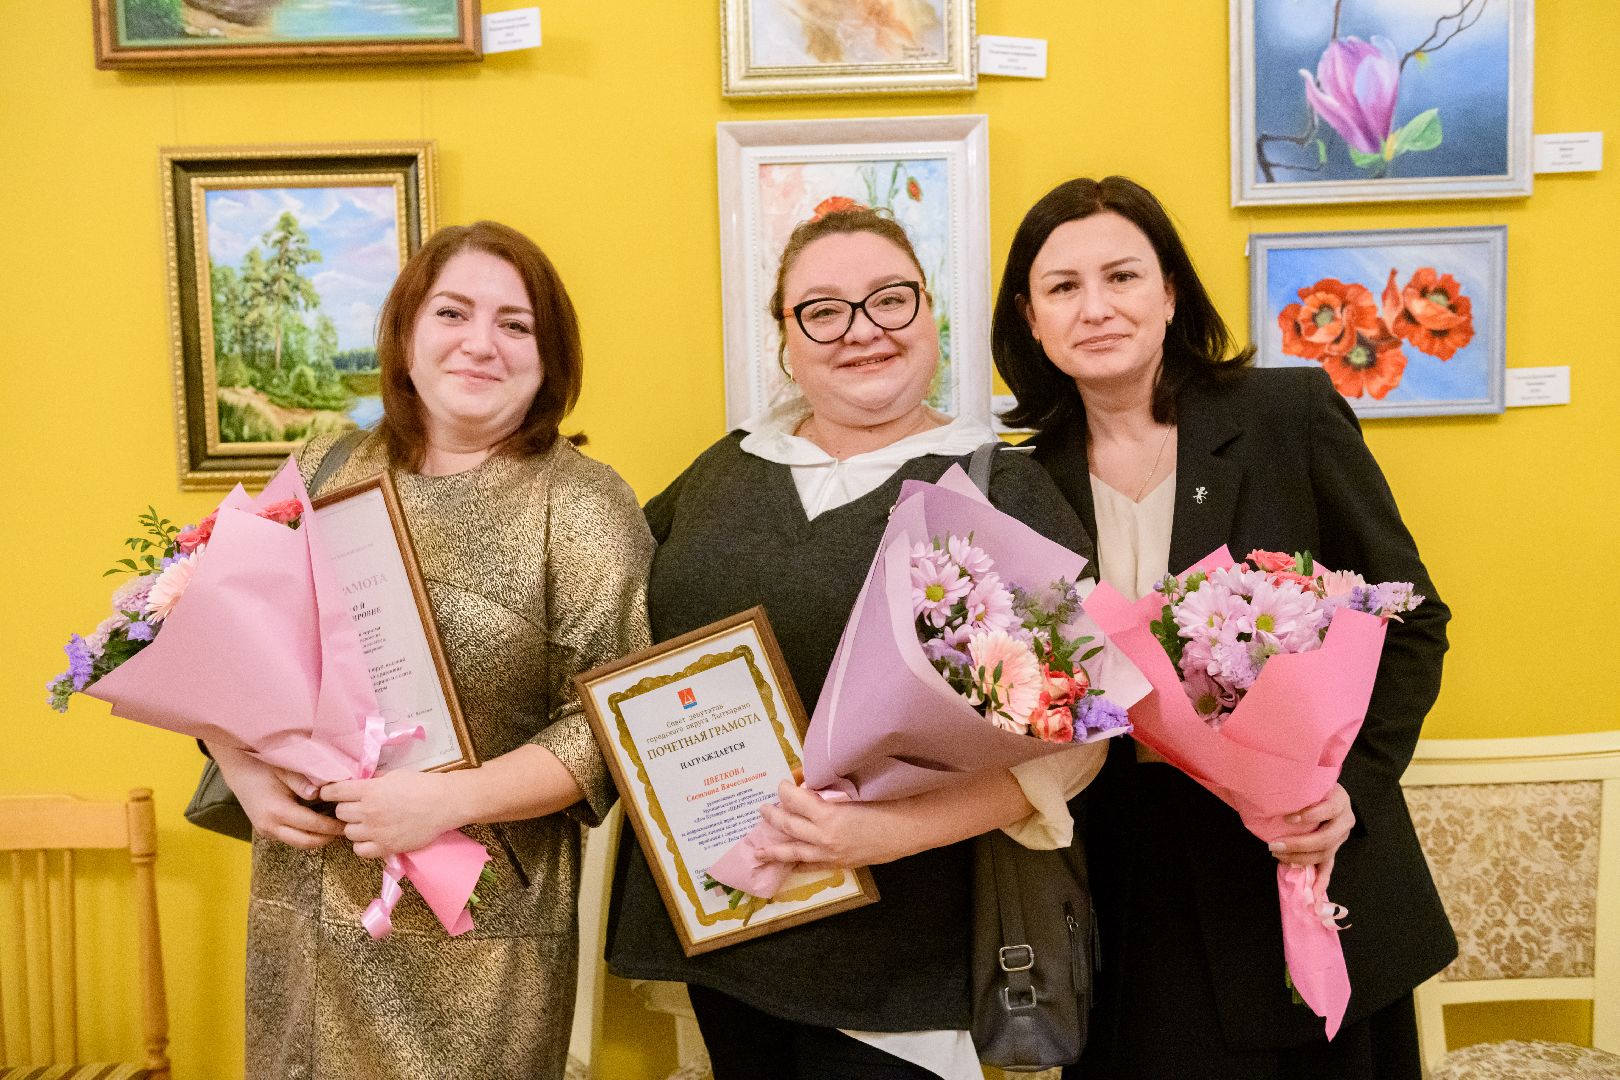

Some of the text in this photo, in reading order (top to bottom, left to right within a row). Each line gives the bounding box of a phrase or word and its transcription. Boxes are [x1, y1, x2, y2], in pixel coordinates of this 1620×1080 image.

[666, 704, 724, 727] Совет депутатов
[647, 727, 684, 744] городского
[686, 718, 709, 730] округа
[648, 712, 761, 759] ПОЧЕТНАЯ ГРАМОТА
[680, 742, 745, 769] НАГРАЖДАЕТСЯ
[687, 772, 767, 802] Светлана Вячеславовна
[703, 766, 745, 786] ЦВЕТКОВА
